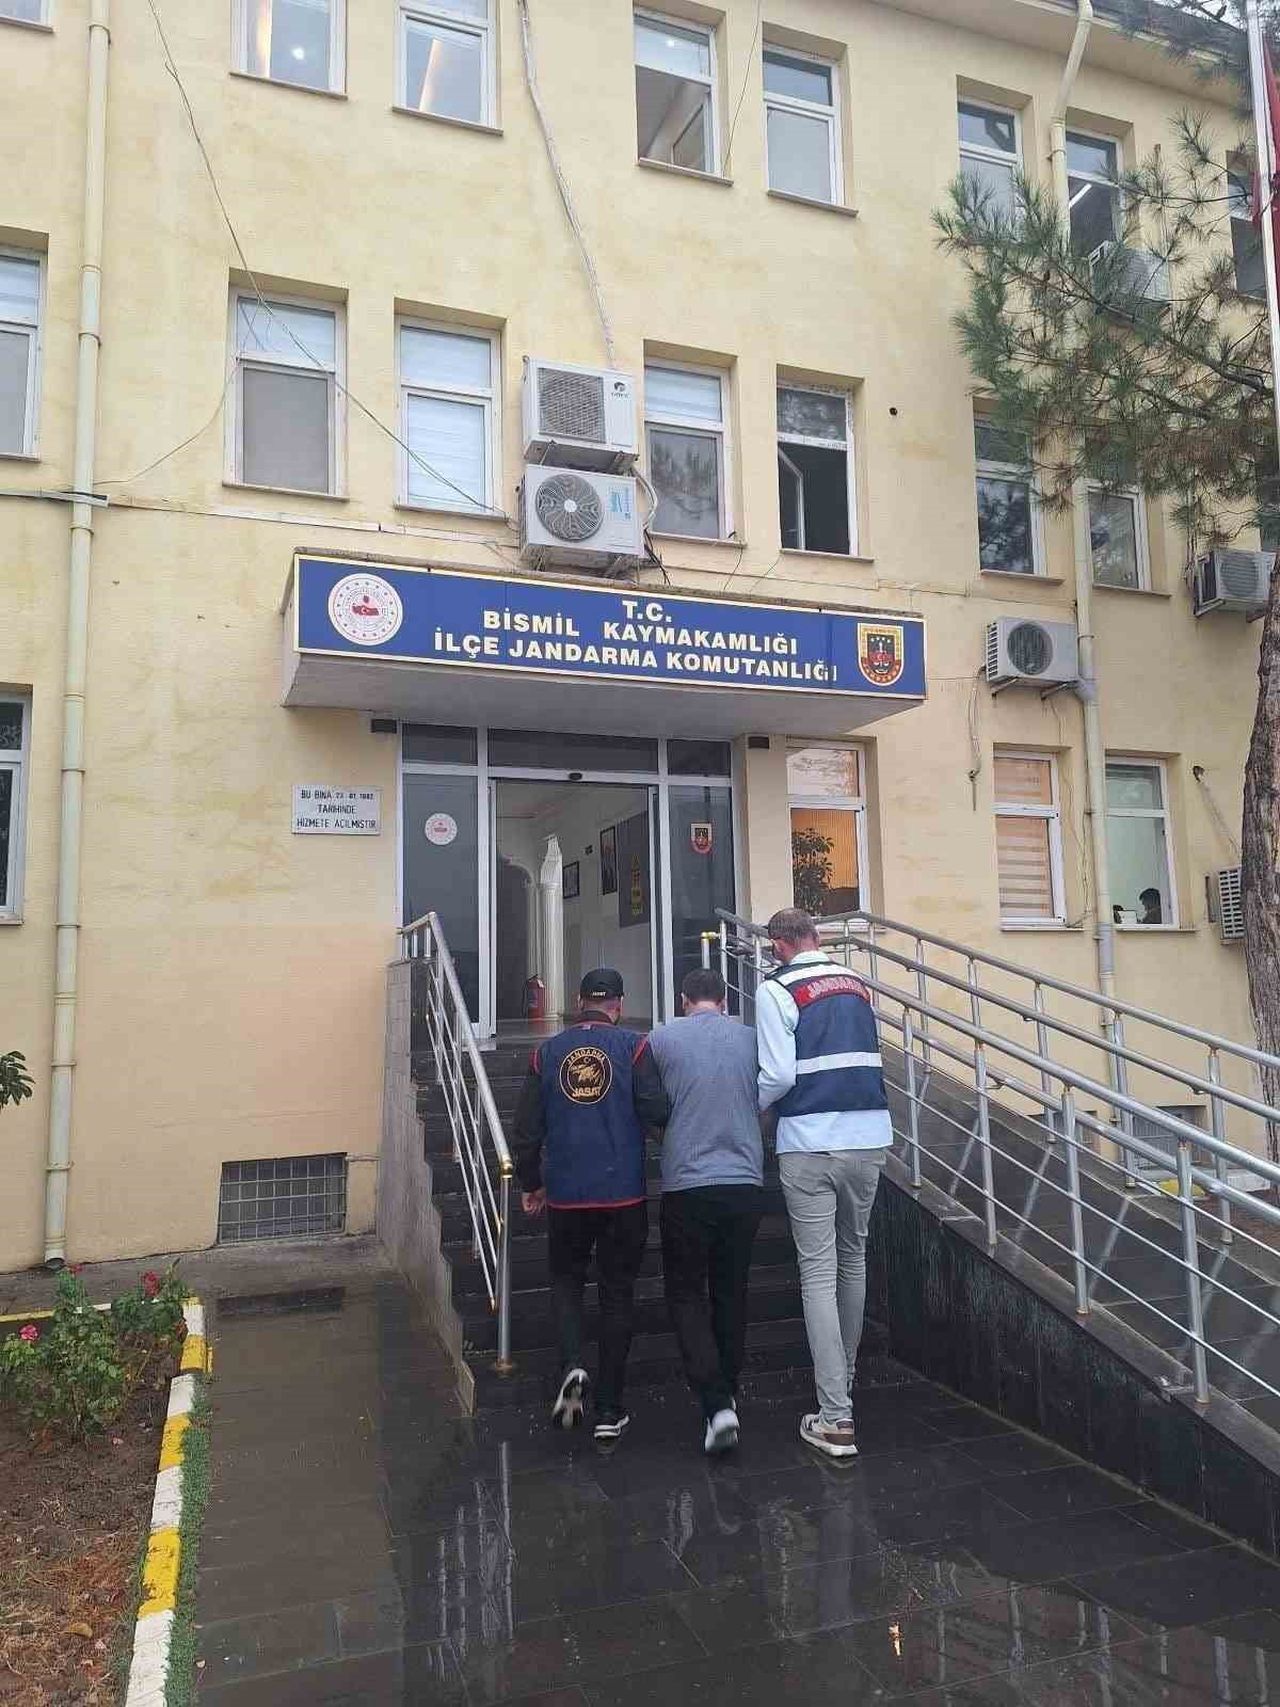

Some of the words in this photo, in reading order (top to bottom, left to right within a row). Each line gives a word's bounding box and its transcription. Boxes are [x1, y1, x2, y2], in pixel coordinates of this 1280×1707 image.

[622, 600, 672, 623] T.C.
[483, 607, 580, 637] BİSMİL
[603, 622, 797, 655] KAYMAKAMLIĞI
[434, 627, 499, 659] İLÇE
[509, 640, 658, 668] JANDARMA
[666, 651, 837, 681] KOMUTANLIĞI
[301, 789, 311, 799] BU
